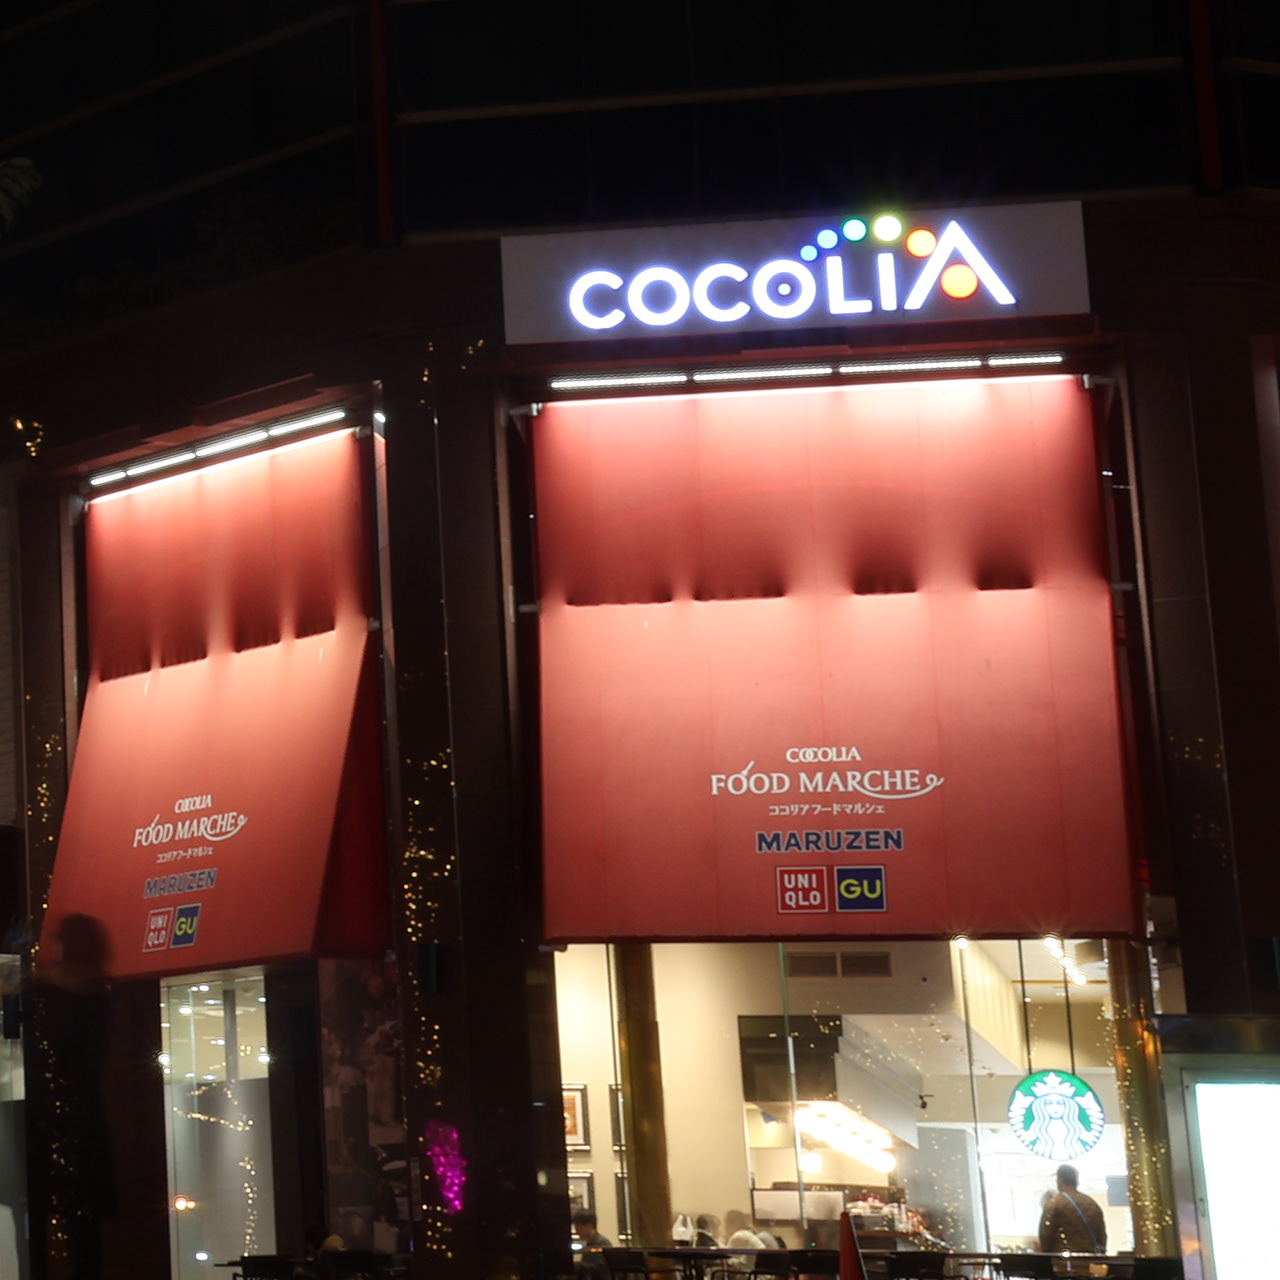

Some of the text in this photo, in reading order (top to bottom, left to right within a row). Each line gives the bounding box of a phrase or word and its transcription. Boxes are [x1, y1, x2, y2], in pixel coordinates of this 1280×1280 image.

[568, 220, 1017, 329] COCOLIA
[710, 761, 791, 796] FOOD
[132, 814, 174, 848] FOOD
[756, 828, 904, 853] MARUZEN
[143, 867, 218, 899] MARUZEN
[784, 873, 818, 889] UNI
[840, 878, 882, 899] GU
[784, 891, 821, 908] QLO
[150, 914, 169, 930] UNI
[175, 917, 198, 936] GU
[147, 930, 167, 947] QLO
